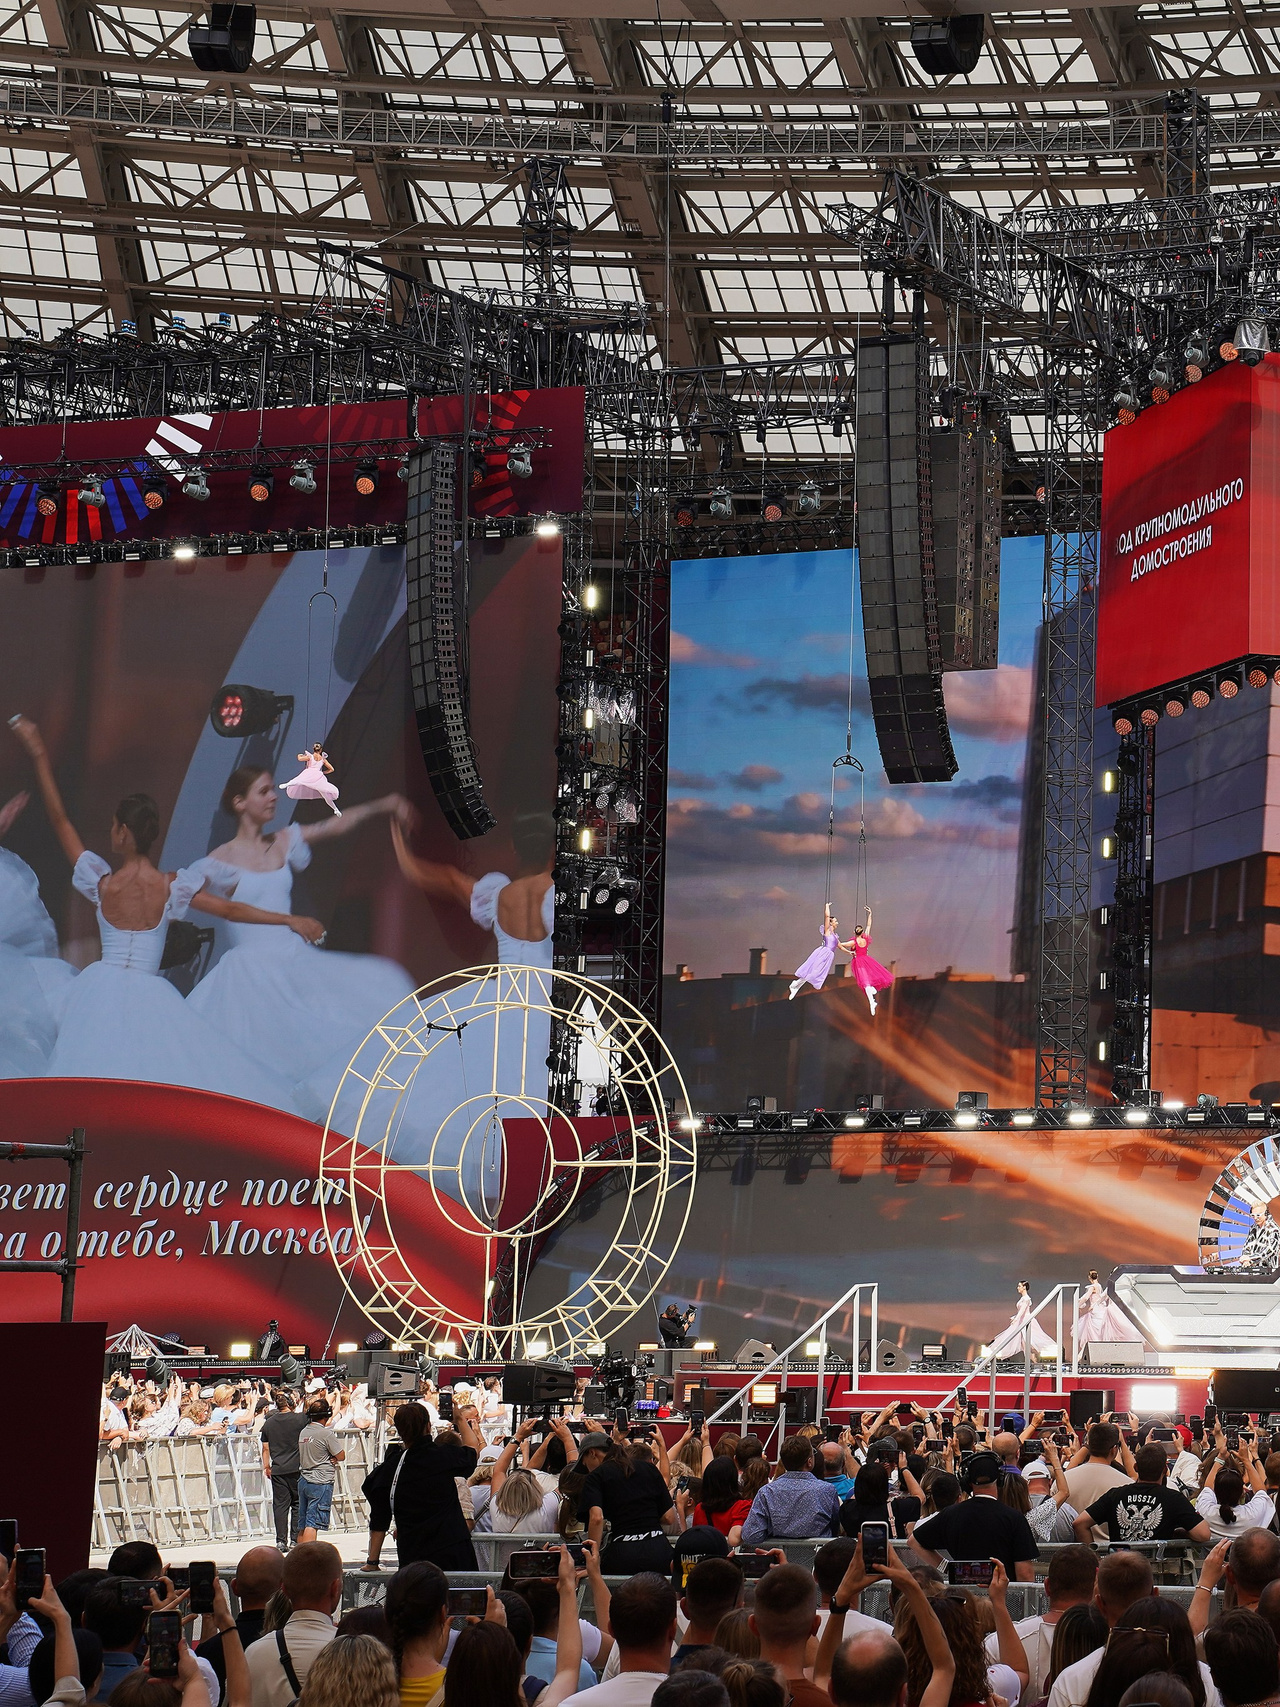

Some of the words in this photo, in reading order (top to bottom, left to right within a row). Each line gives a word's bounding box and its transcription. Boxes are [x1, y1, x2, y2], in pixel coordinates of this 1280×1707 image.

[1135, 477, 1244, 547] КРУПНОМОДУЛЬНОГО
[1131, 525, 1213, 582] ДОМОСТРОЕНИЯ
[93, 1169, 229, 1217] сердце
[241, 1177, 346, 1206] поет
[0, 1231, 27, 1259] а
[40, 1231, 62, 1259] о
[76, 1218, 183, 1262] тебе,
[1127, 1494, 1157, 1505] RUSSIA
